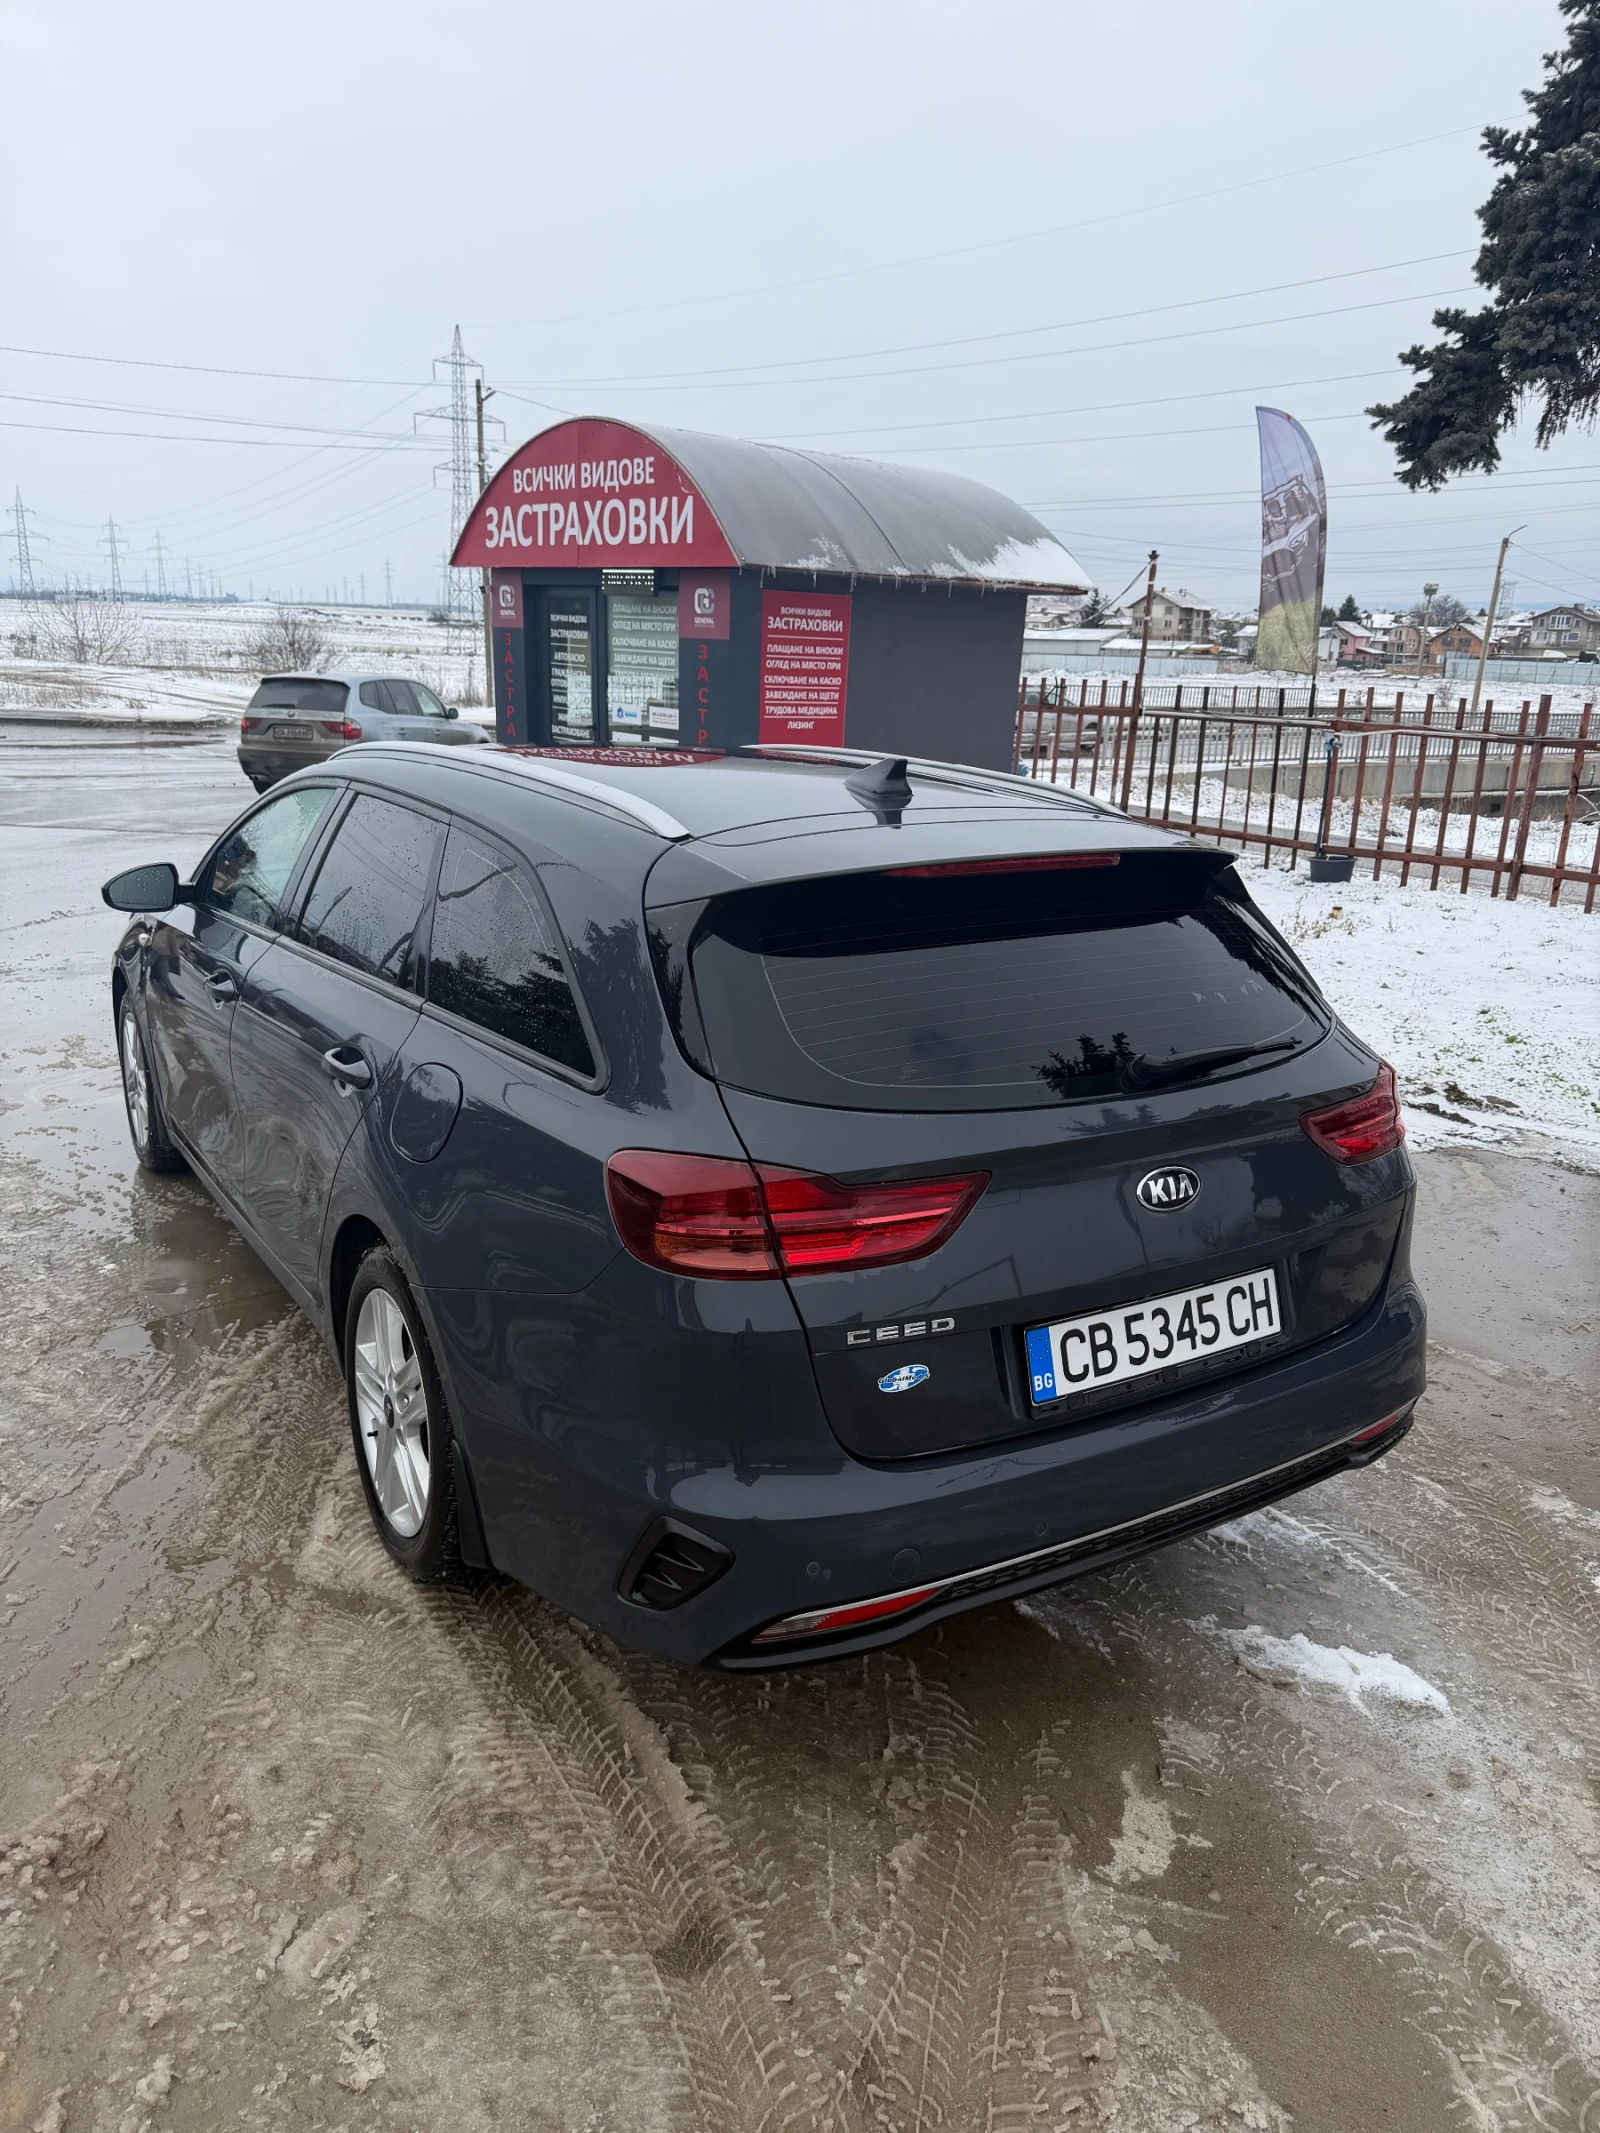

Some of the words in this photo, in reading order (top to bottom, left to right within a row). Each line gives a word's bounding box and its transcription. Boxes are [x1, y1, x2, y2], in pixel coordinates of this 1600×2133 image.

[513, 463, 576, 494] ВСИЧКИ
[580, 457, 655, 493] ВИДОВЕ
[485, 495, 694, 548] ЗАСТРАХОВКИ
[780, 607, 806, 616] ВСИЧКИ
[807, 608, 832, 618] ВИДОВЕ
[613, 620, 632, 631] ОГЛЕД
[632, 621, 640, 630] НА
[641, 621, 662, 631] МЯСТО
[663, 622, 676, 632] ПРИ
[694, 617, 715, 625] GENERAL
[767, 616, 843, 632] ЗАСТРАХОВКИ
[550, 629, 588, 640] ЗАСТРАХОВКИ
[612, 637, 647, 647] СКЛЮЧВАНЕ
[648, 639, 657, 648] НА
[657, 640, 677, 649] КАСКО
[767, 644, 804, 654] ПЛАЩАНЕ
[805, 646, 815, 654] НА
[816, 646, 843, 656] ВНОСКИ
[613, 653, 648, 665] ЗАВЕЖДАНЕ
[648, 656, 657, 665] НА
[658, 657, 676, 667] ЩЕТИ
[766, 660, 789, 670] ОГЛЕД
[790, 661, 800, 669] НА
[801, 661, 826, 670] МЯСТО
[827, 662, 841, 670] ПРИ
[764, 675, 807, 685] СКЛЮЧВАНЕ
[808, 676, 818, 685] НА
[819, 677, 842, 686] КАСКО
[765, 690, 807, 700] ЗАВЕЖДАНЕ
[808, 691, 818, 699] НА
[819, 692, 839, 701] ЩЕТИ
[765, 706, 796, 715] ТРУДОВА
[798, 706, 837, 716] МЕДИЦИНА
[787, 721, 814, 729] ЛИЗИНГ
[1147, 1174, 1194, 1204] KIA
[847, 1317, 955, 1345] CEED
[1060, 1321, 1118, 1383] CB
[1123, 1293, 1221, 1366] 5345
[1226, 1278, 1274, 1337] CH
[1033, 1373, 1053, 1392] BG
